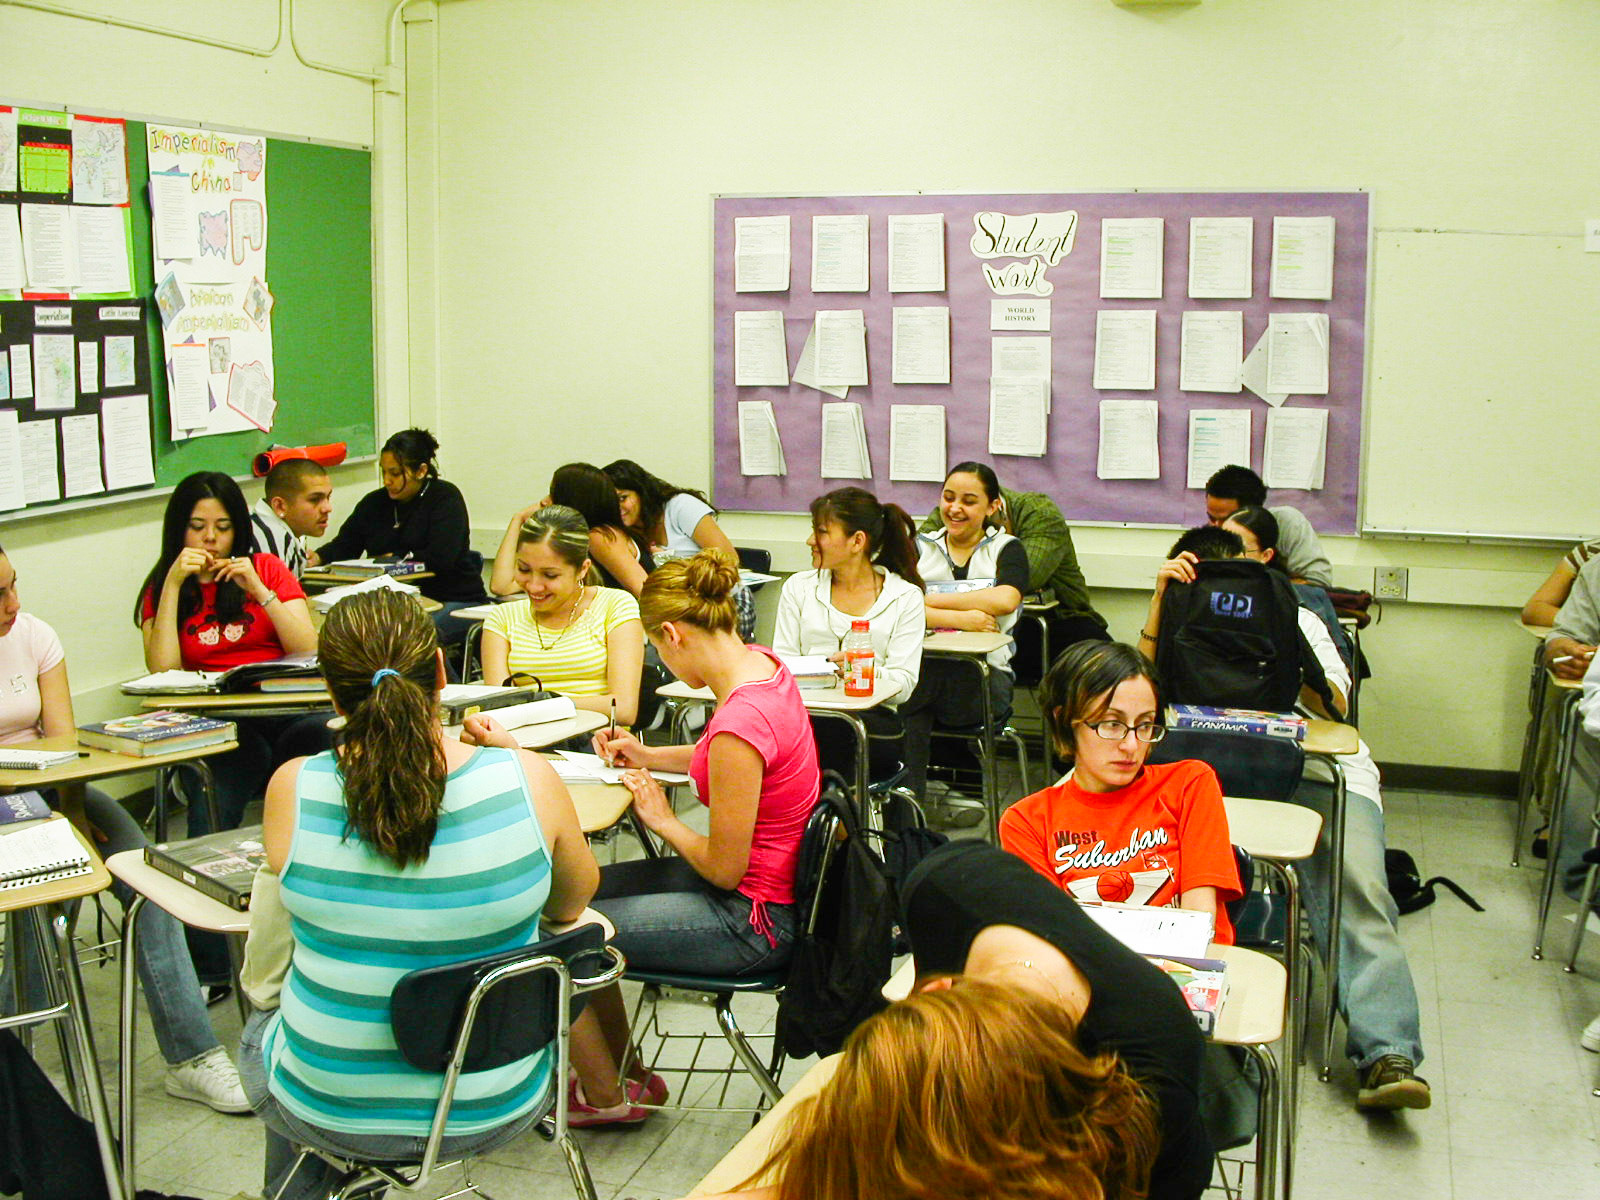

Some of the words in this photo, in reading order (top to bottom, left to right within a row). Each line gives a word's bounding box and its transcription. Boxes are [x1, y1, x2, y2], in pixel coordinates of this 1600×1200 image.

[151, 130, 235, 160] Imperialism
[191, 171, 231, 191] China
[973, 212, 1075, 264] Student
[1053, 829, 1099, 848] West
[1054, 827, 1169, 875] Suburban
